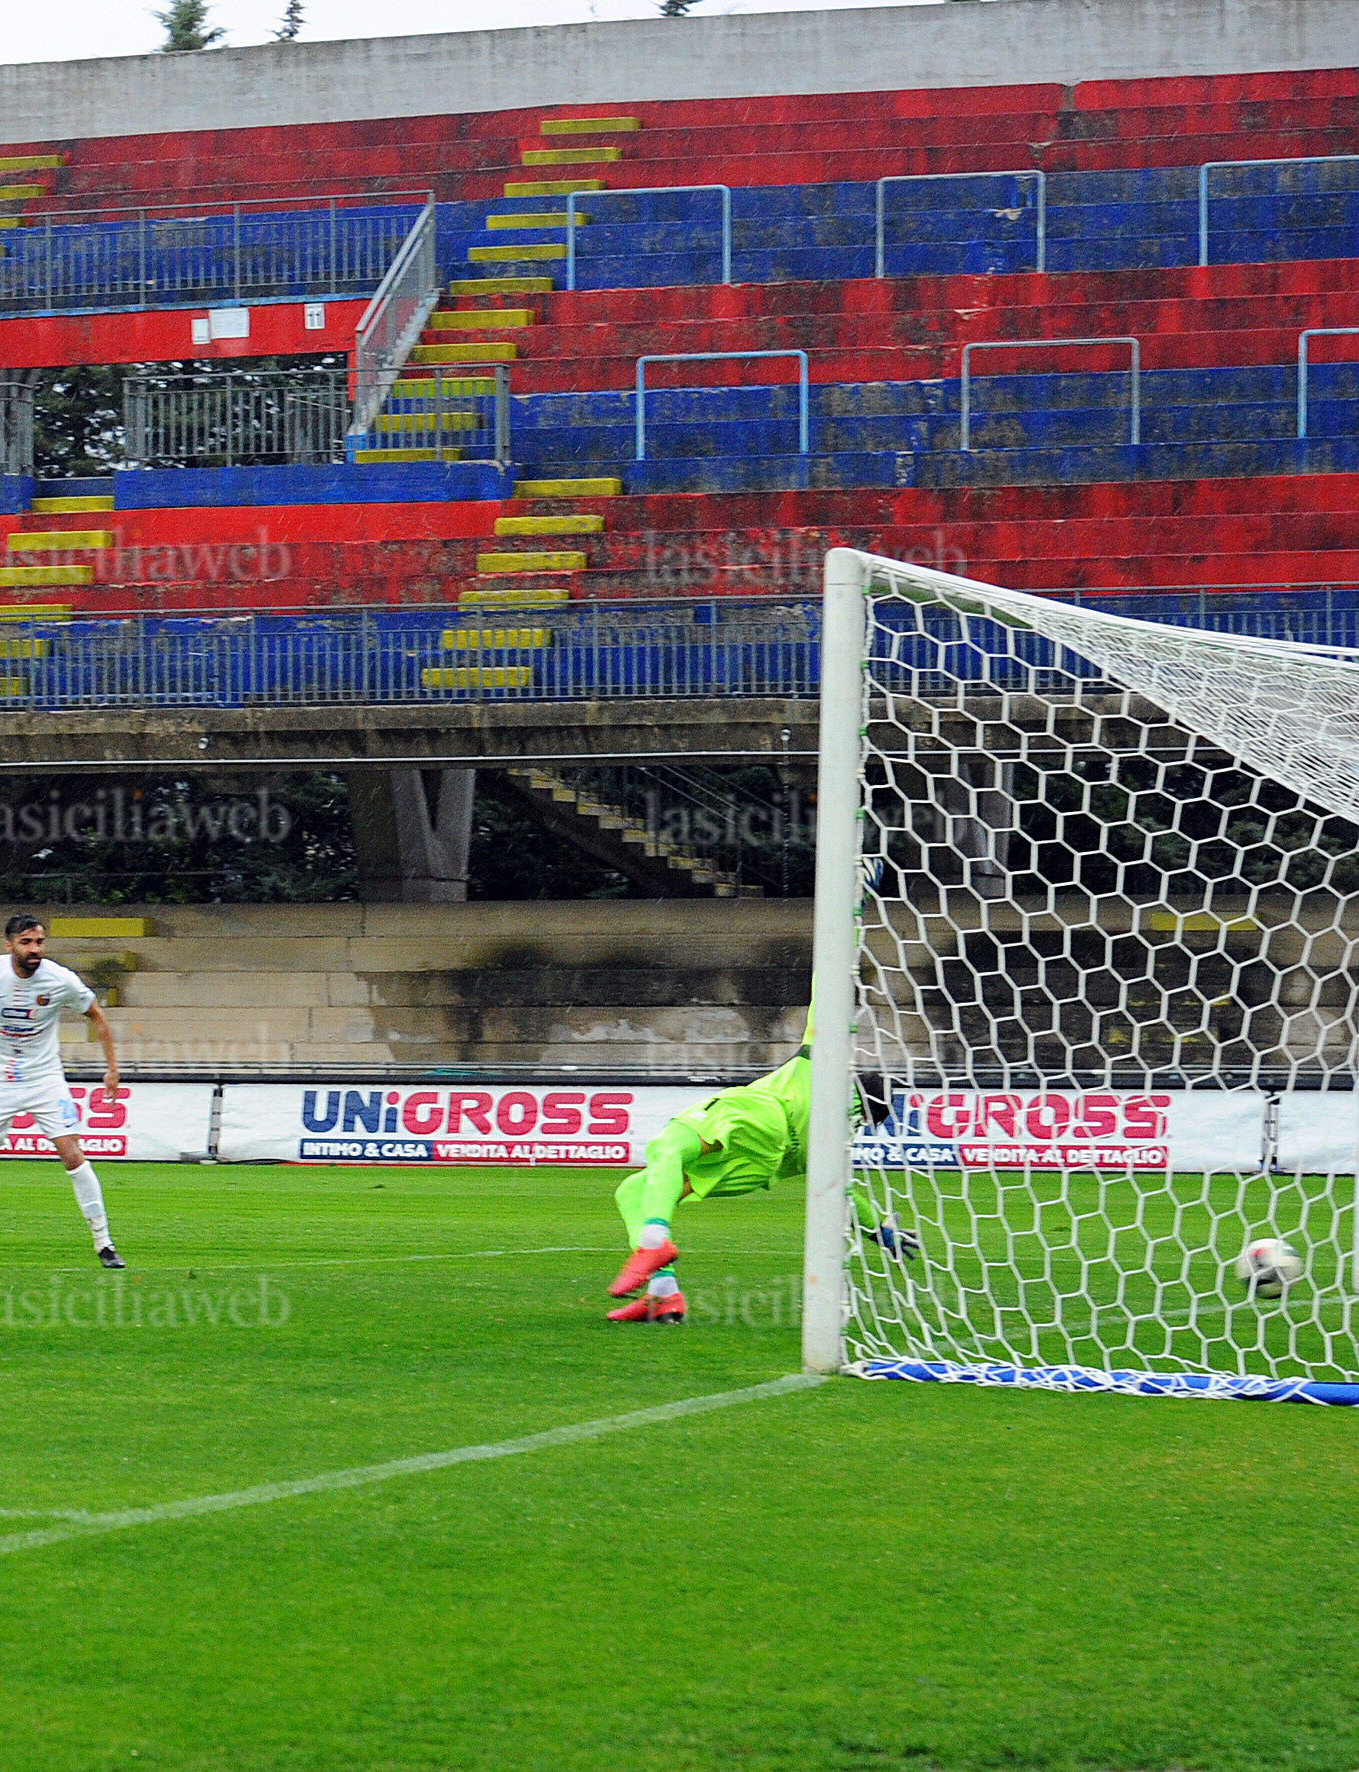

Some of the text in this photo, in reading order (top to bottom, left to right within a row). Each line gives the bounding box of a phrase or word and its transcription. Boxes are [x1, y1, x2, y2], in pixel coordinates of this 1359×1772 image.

[302, 1090, 632, 1135] UNiGROSS
[14, 1138, 35, 1150] AL
[303, 1142, 626, 1160] INTIMO & CASA VENDITA AL DETTAGLIO
[905, 1148, 954, 1162] CASA
